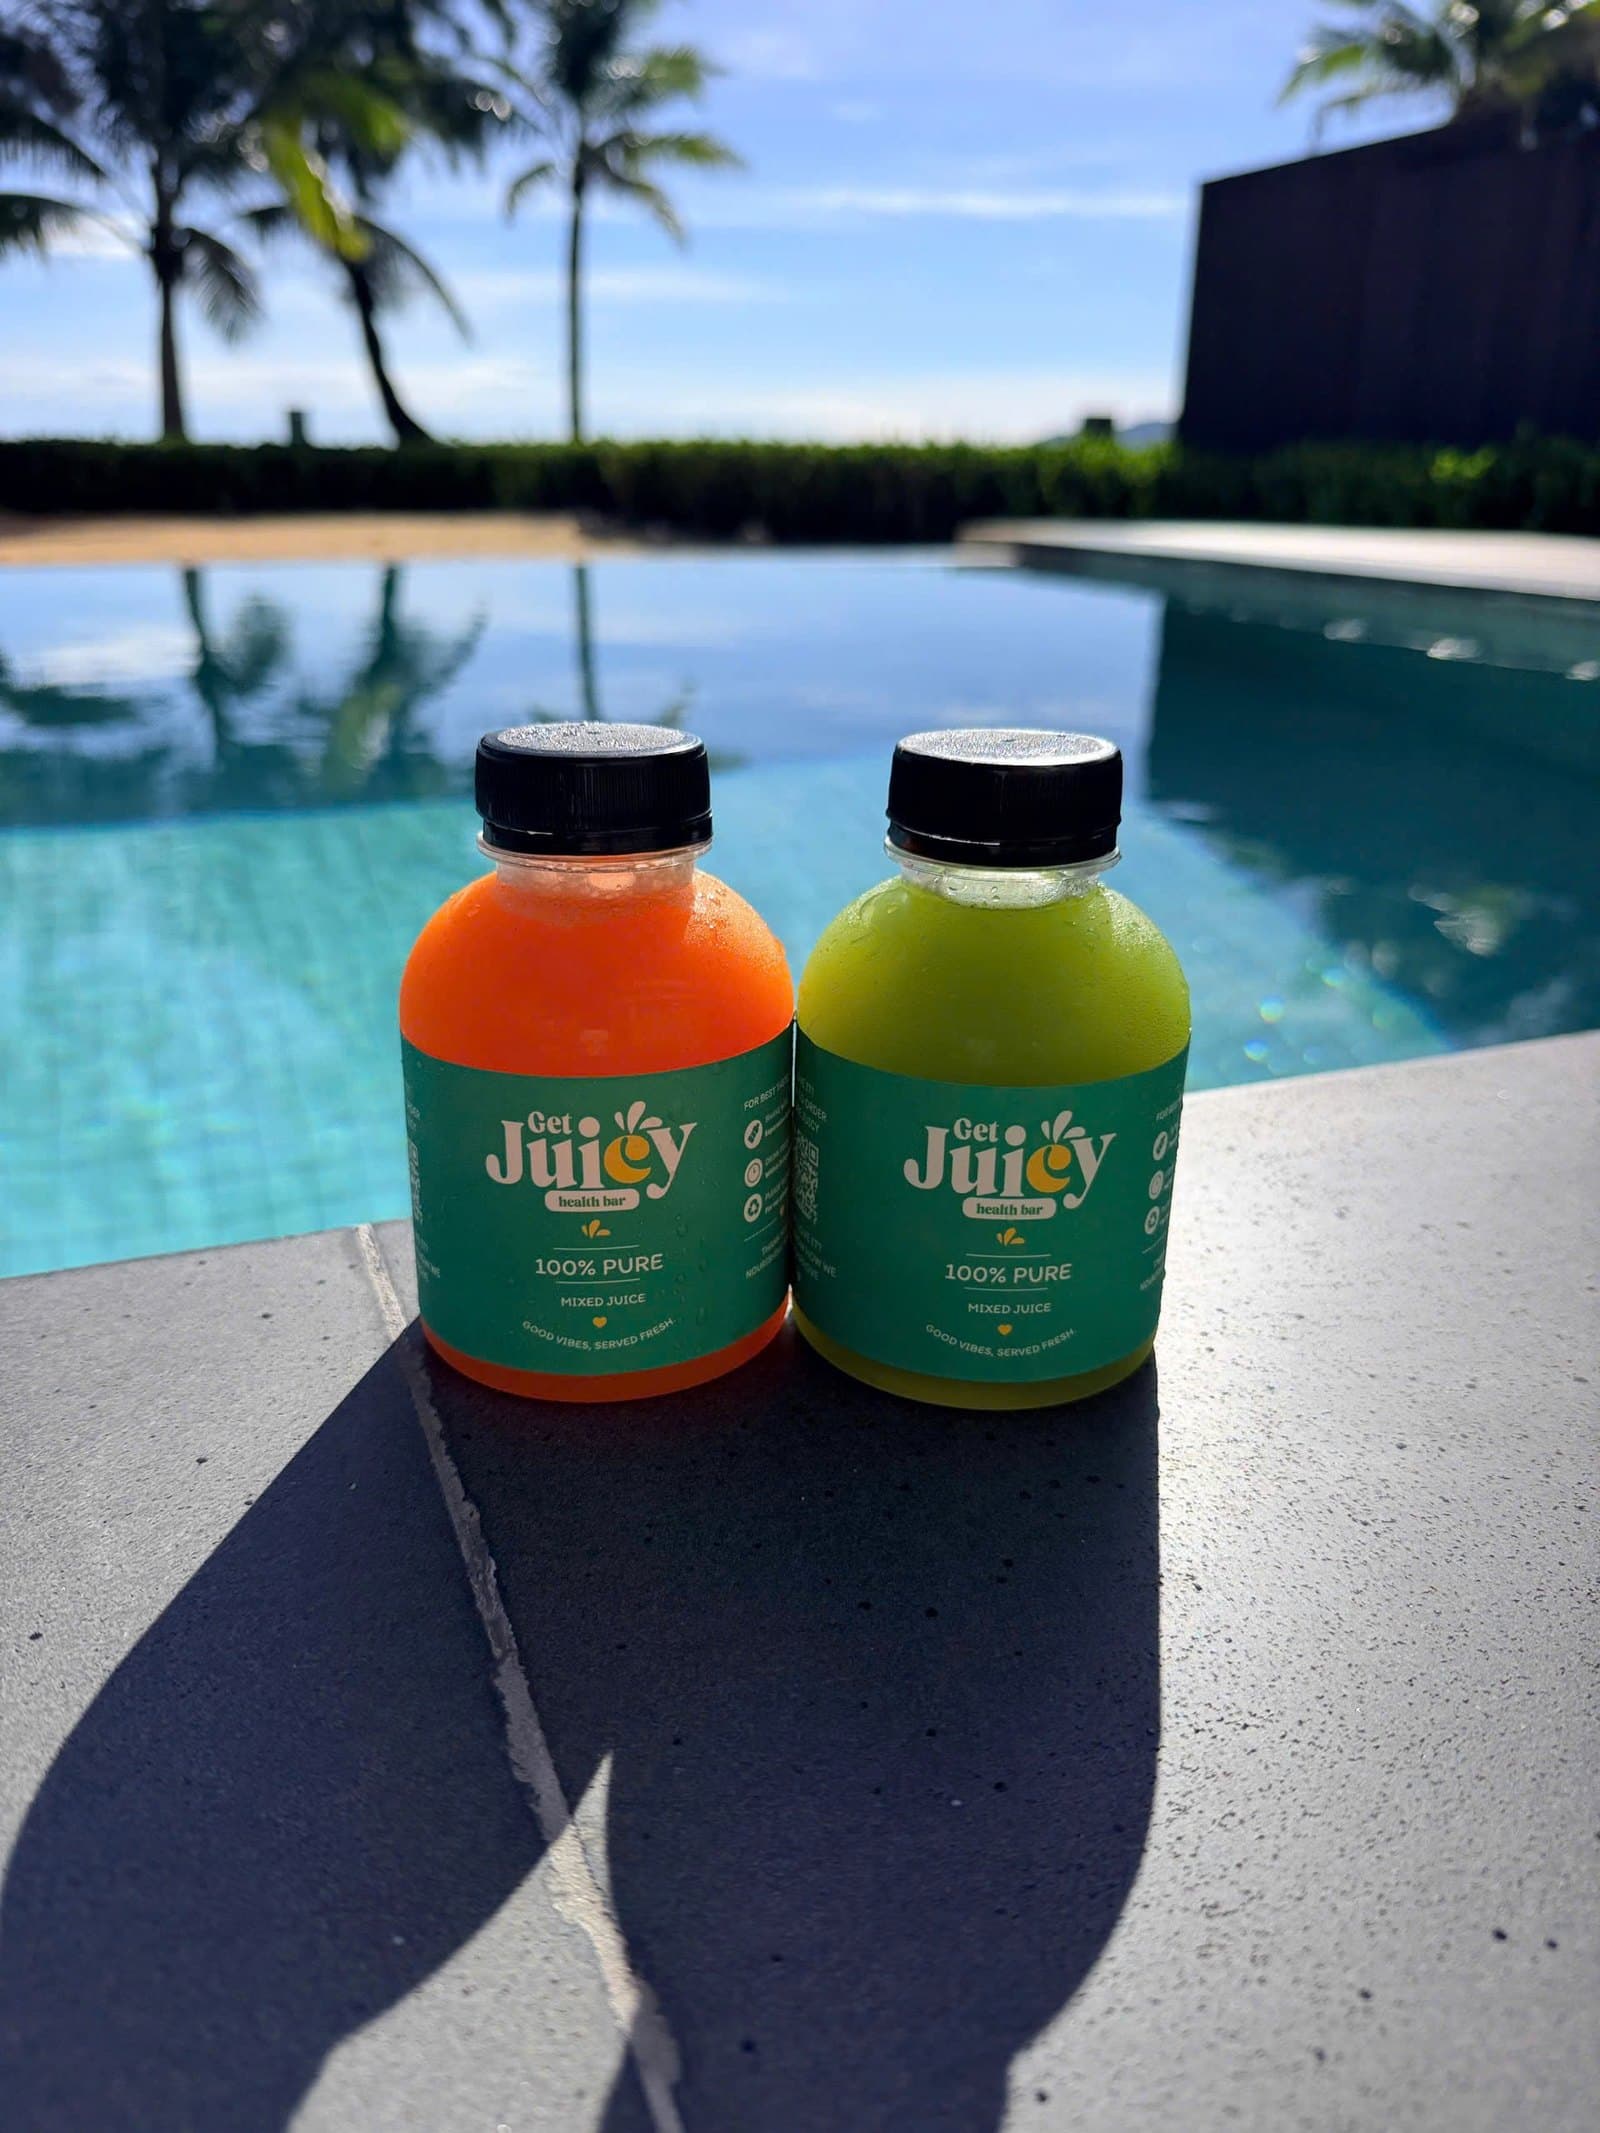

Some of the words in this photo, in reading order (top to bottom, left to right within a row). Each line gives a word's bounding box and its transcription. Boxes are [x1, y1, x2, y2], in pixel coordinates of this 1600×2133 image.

[528, 1111, 573, 1135] Get
[953, 1117, 999, 1143] Get
[486, 1117, 698, 1199] Juicy
[903, 1124, 1117, 1209] Juicy
[558, 1196, 600, 1207] health
[603, 1196, 626, 1206] bar
[976, 1203, 1017, 1215] health
[1020, 1203, 1043, 1215] bar
[535, 1258, 596, 1276] 100%
[603, 1253, 664, 1276] PURE
[945, 1264, 1006, 1283] 100%
[1013, 1263, 1072, 1283] PURE
[561, 1297, 604, 1307] MIXED
[607, 1293, 647, 1306] JUICE
[968, 1303, 1011, 1314] MIXED
[1013, 1303, 1051, 1314] JUICE
[522, 1320, 554, 1341] GOOD
[556, 1335, 592, 1351] VIBES,
[594, 1335, 638, 1350] SERVED
[926, 1324, 957, 1345] GOOD
[996, 1344, 1040, 1357] SERVED
